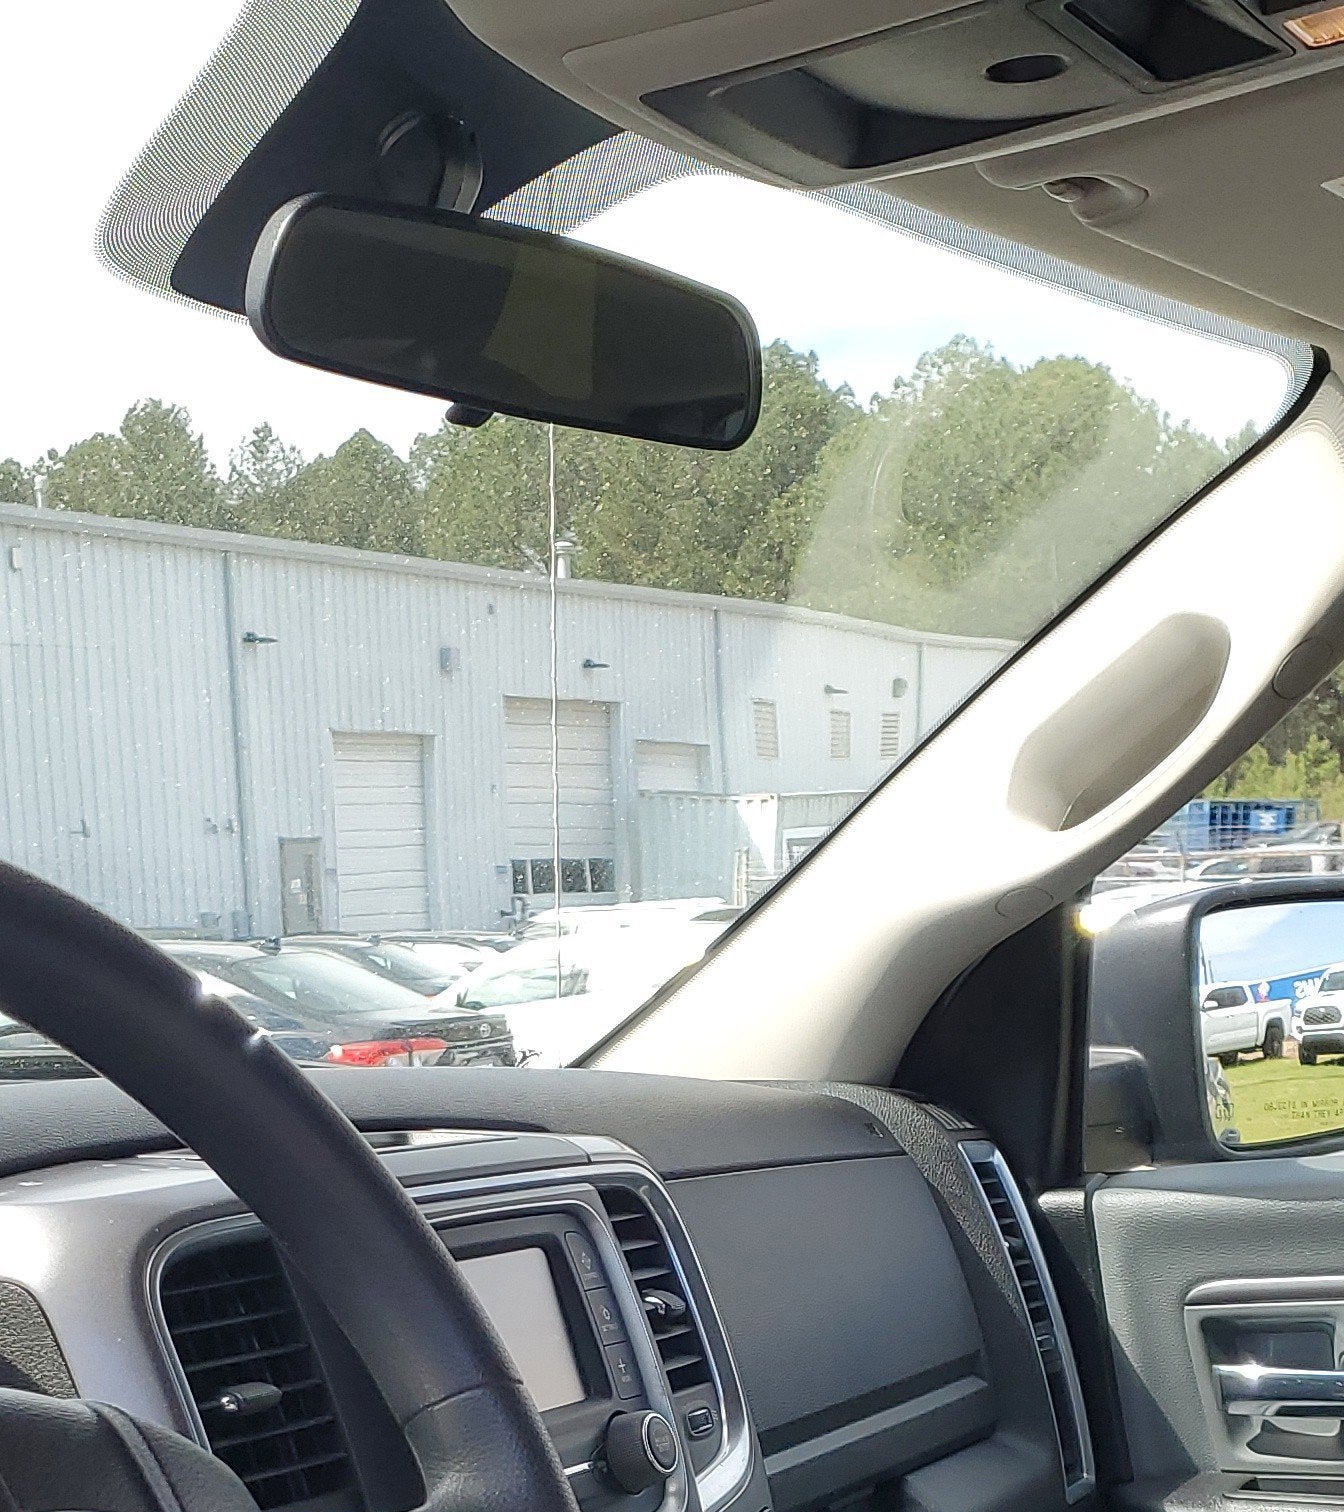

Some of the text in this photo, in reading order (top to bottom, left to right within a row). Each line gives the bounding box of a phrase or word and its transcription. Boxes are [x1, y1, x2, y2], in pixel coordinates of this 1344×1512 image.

[1263, 1100, 1297, 1112] OBJECTS
[1300, 1101, 1309, 1109] IN
[1291, 1110, 1311, 1120] THAN
[1313, 1109, 1332, 1119] THEY
